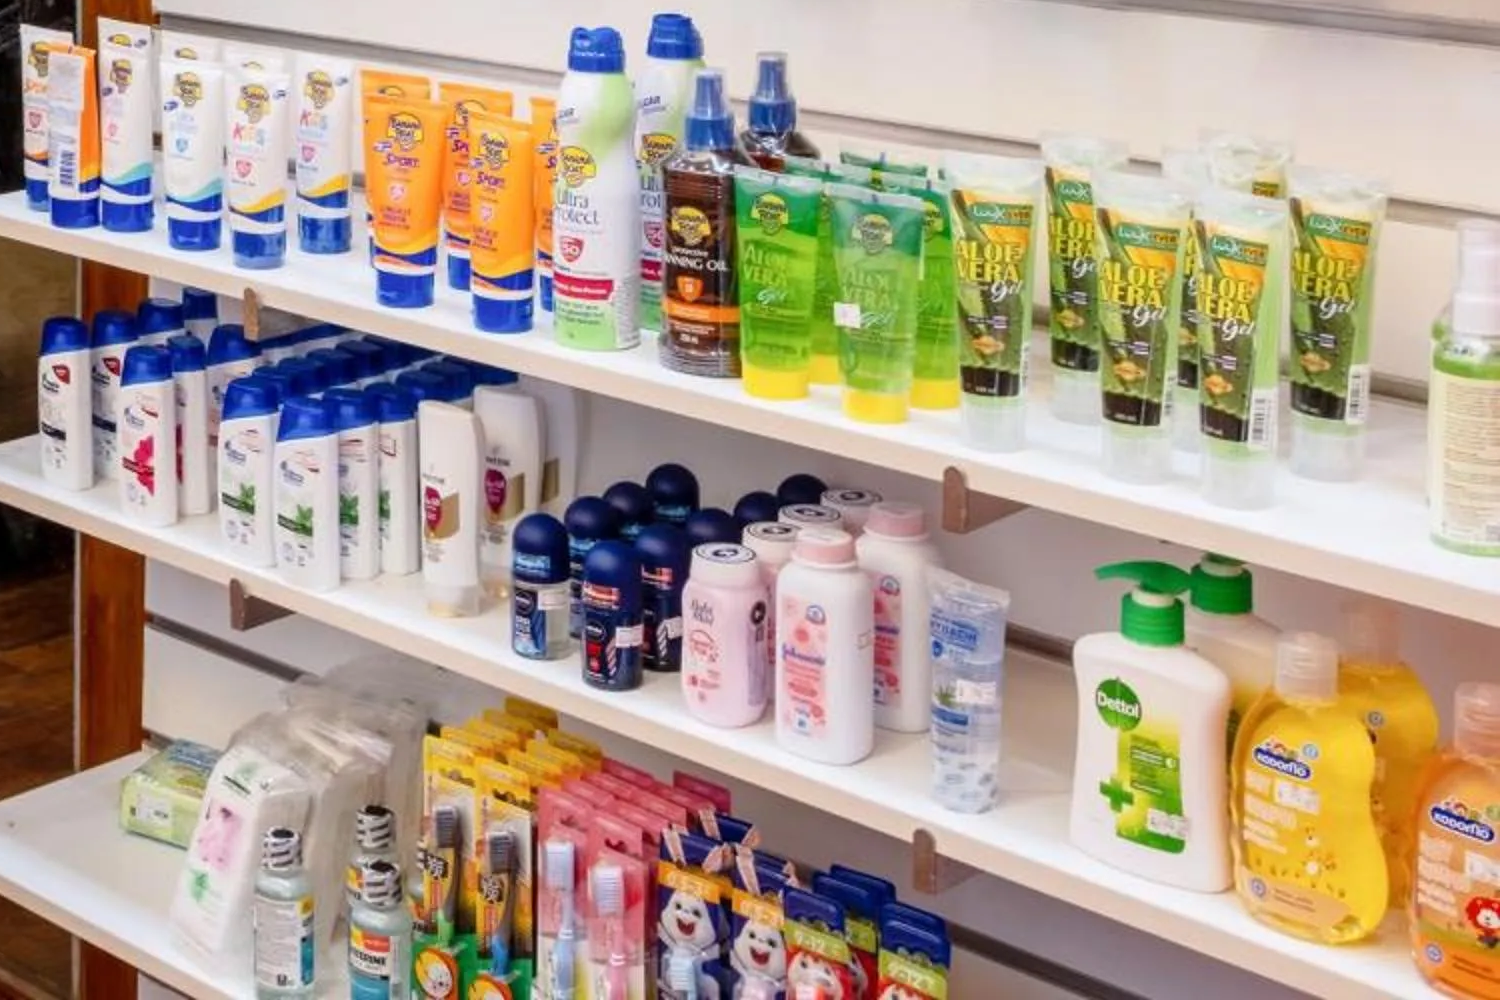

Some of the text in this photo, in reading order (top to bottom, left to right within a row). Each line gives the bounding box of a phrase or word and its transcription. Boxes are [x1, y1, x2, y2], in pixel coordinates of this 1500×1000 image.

[386, 152, 421, 168] SPORT
[475, 171, 506, 187] SPORT
[743, 243, 789, 267] ALOE
[956, 239, 1024, 264] ALOE
[743, 264, 789, 288] VERA
[957, 260, 1020, 284] VERA
[1099, 260, 1165, 289] ALOE
[1099, 281, 1164, 309] VERA
[1196, 271, 1254, 302] ALOE
[1096, 691, 1143, 720] Dettol
